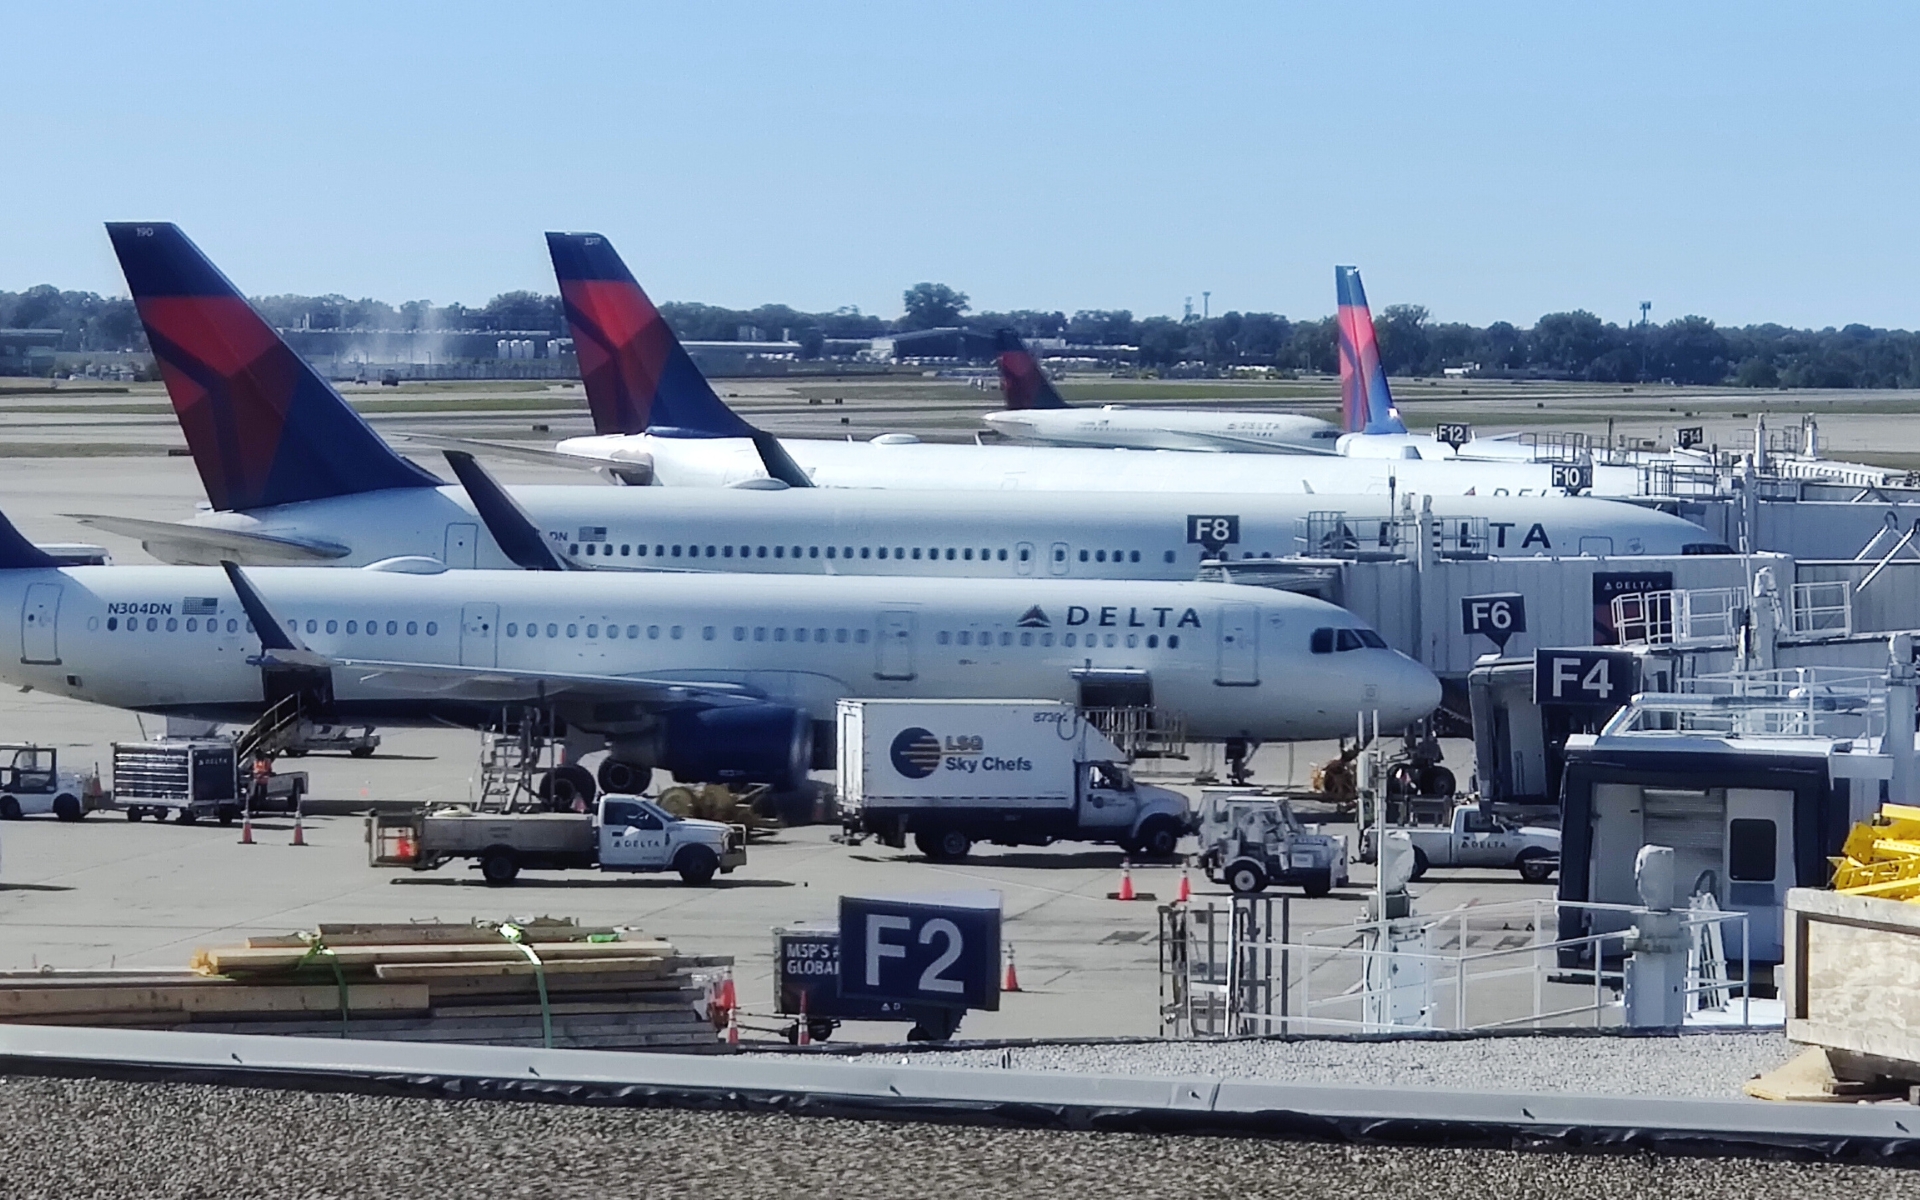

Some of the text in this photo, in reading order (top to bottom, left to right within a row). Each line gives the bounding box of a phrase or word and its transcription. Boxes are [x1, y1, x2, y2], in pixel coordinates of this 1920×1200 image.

[1438, 425, 1464, 442] F12
[1681, 429, 1700, 444] F14
[1554, 467, 1580, 486] F10
[1195, 518, 1230, 541] F8
[1615, 581, 1653, 590] DELTA
[107, 602, 173, 615] N304DN
[1066, 605, 1202, 628] DELTA
[1471, 601, 1512, 630] F6
[1552, 657, 1614, 699] F4
[945, 756, 1032, 774] Sky Chefs
[624, 840, 660, 848] DELTA
[1471, 840, 1506, 849] DELTA
[786, 943, 831, 959] MSP'S
[865, 913, 965, 994] F2
